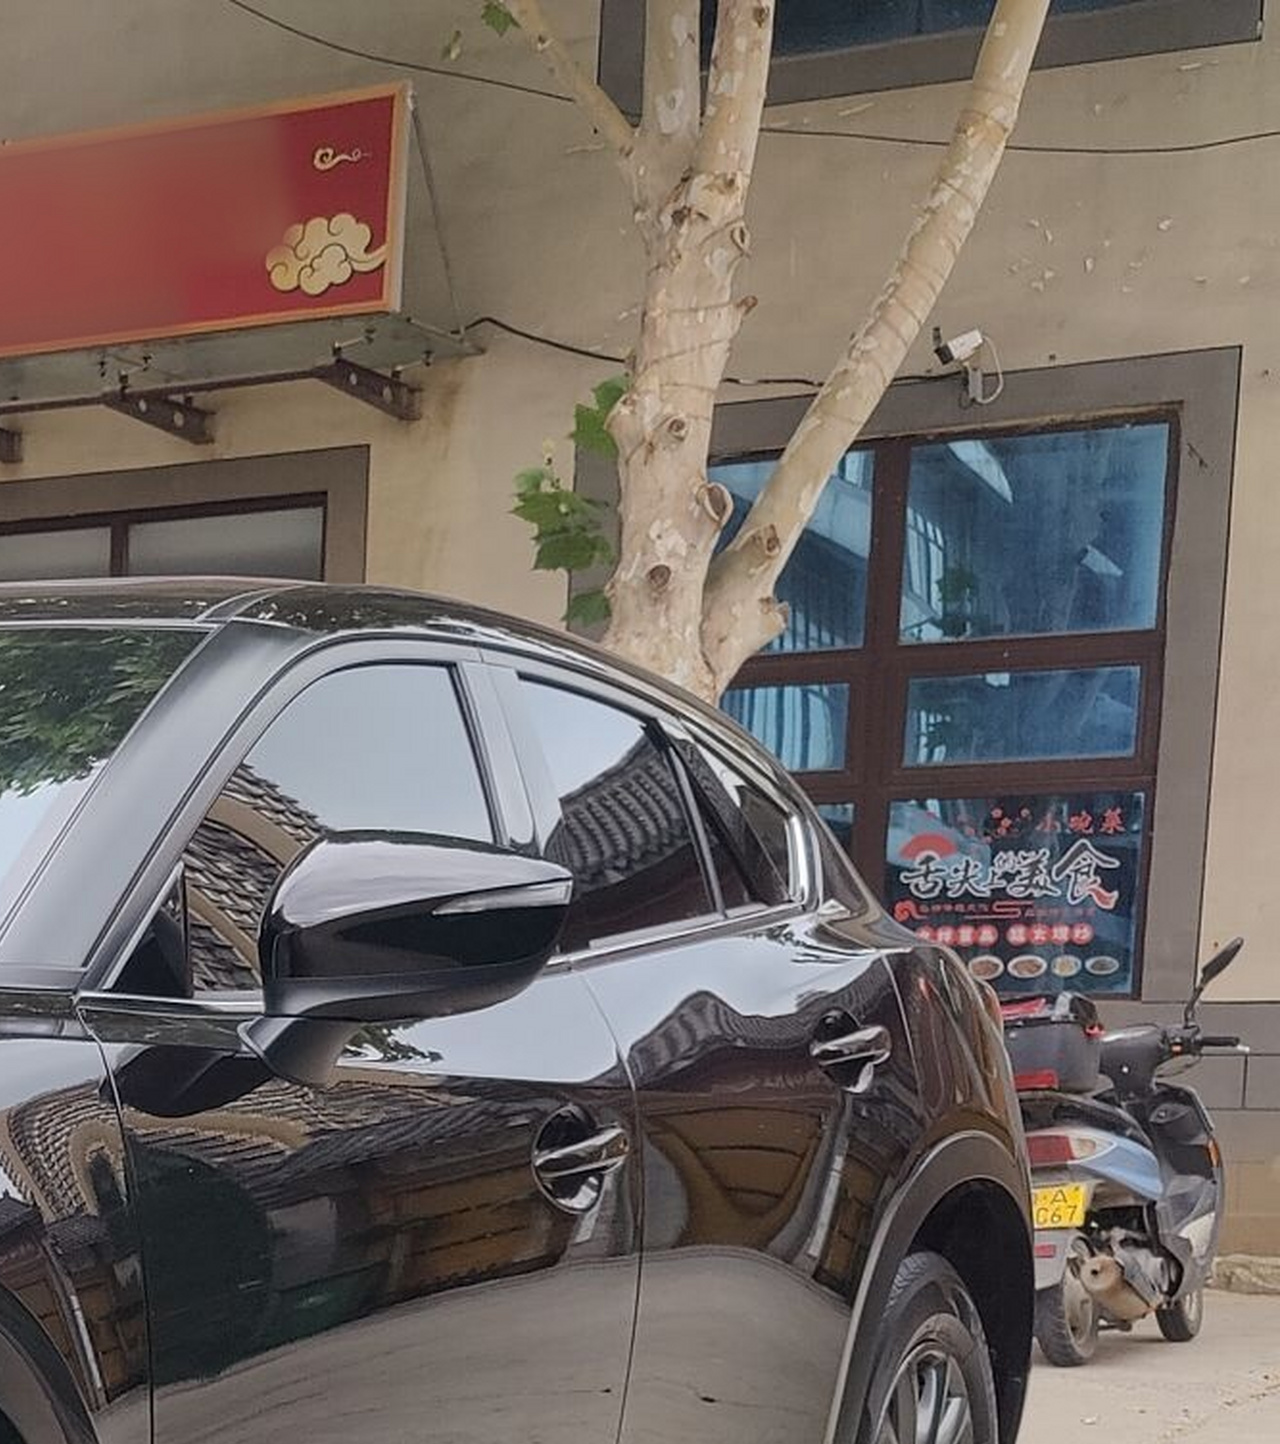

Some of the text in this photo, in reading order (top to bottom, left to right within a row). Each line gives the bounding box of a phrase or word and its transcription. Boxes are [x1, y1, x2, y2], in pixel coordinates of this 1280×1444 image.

[1036, 807, 1124, 833] 小碗菜
[901, 839, 1121, 909] 舌尖上的美食
